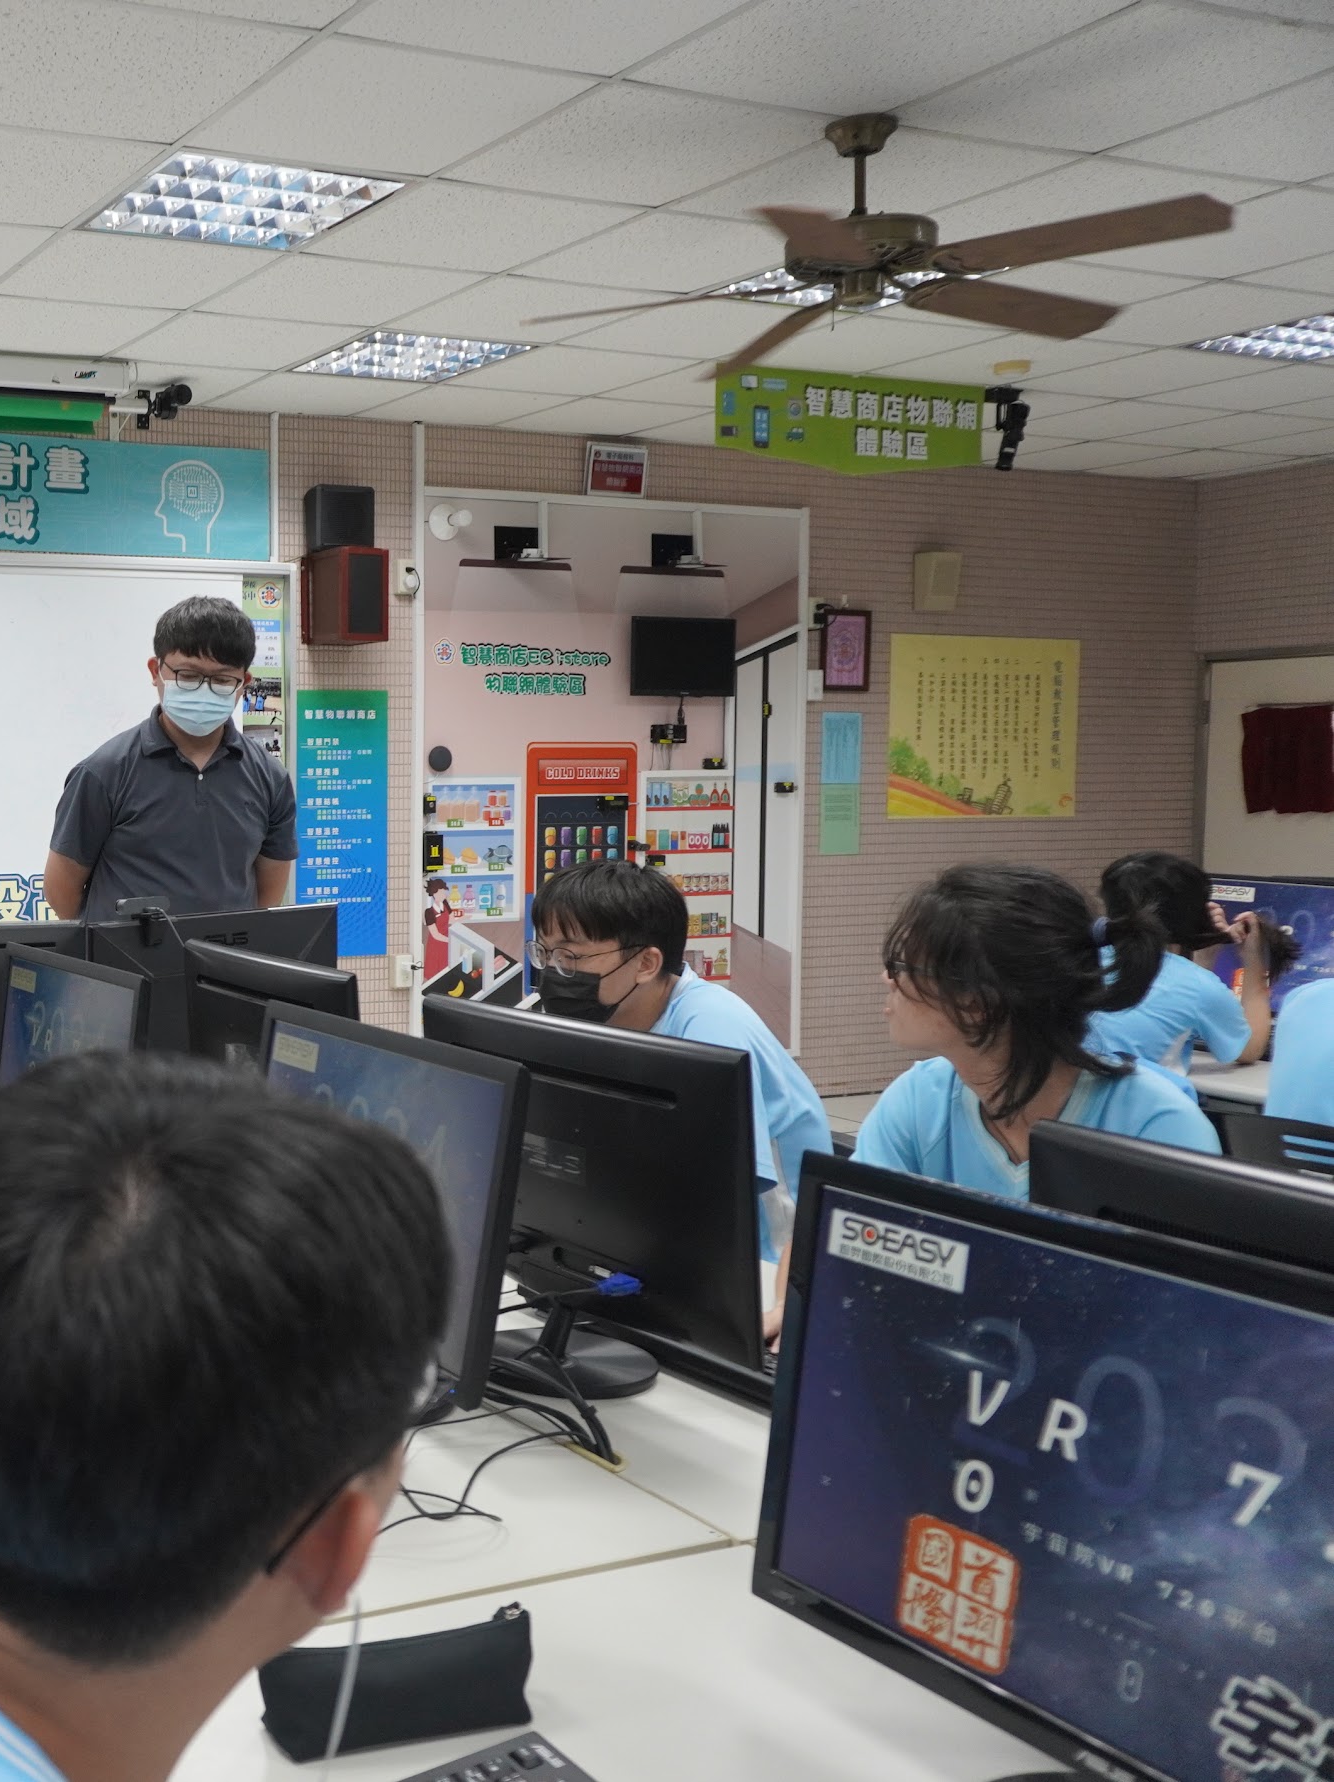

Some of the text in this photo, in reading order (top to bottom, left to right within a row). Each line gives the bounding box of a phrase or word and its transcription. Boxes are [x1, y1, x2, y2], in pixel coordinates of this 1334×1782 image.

[805, 386, 978, 430] 智慧商店物聯網
[855, 426, 928, 461] 體驗區
[485, 673, 586, 696] 物聯網體驗區
[546, 766, 620, 780] COLD DRINKS
